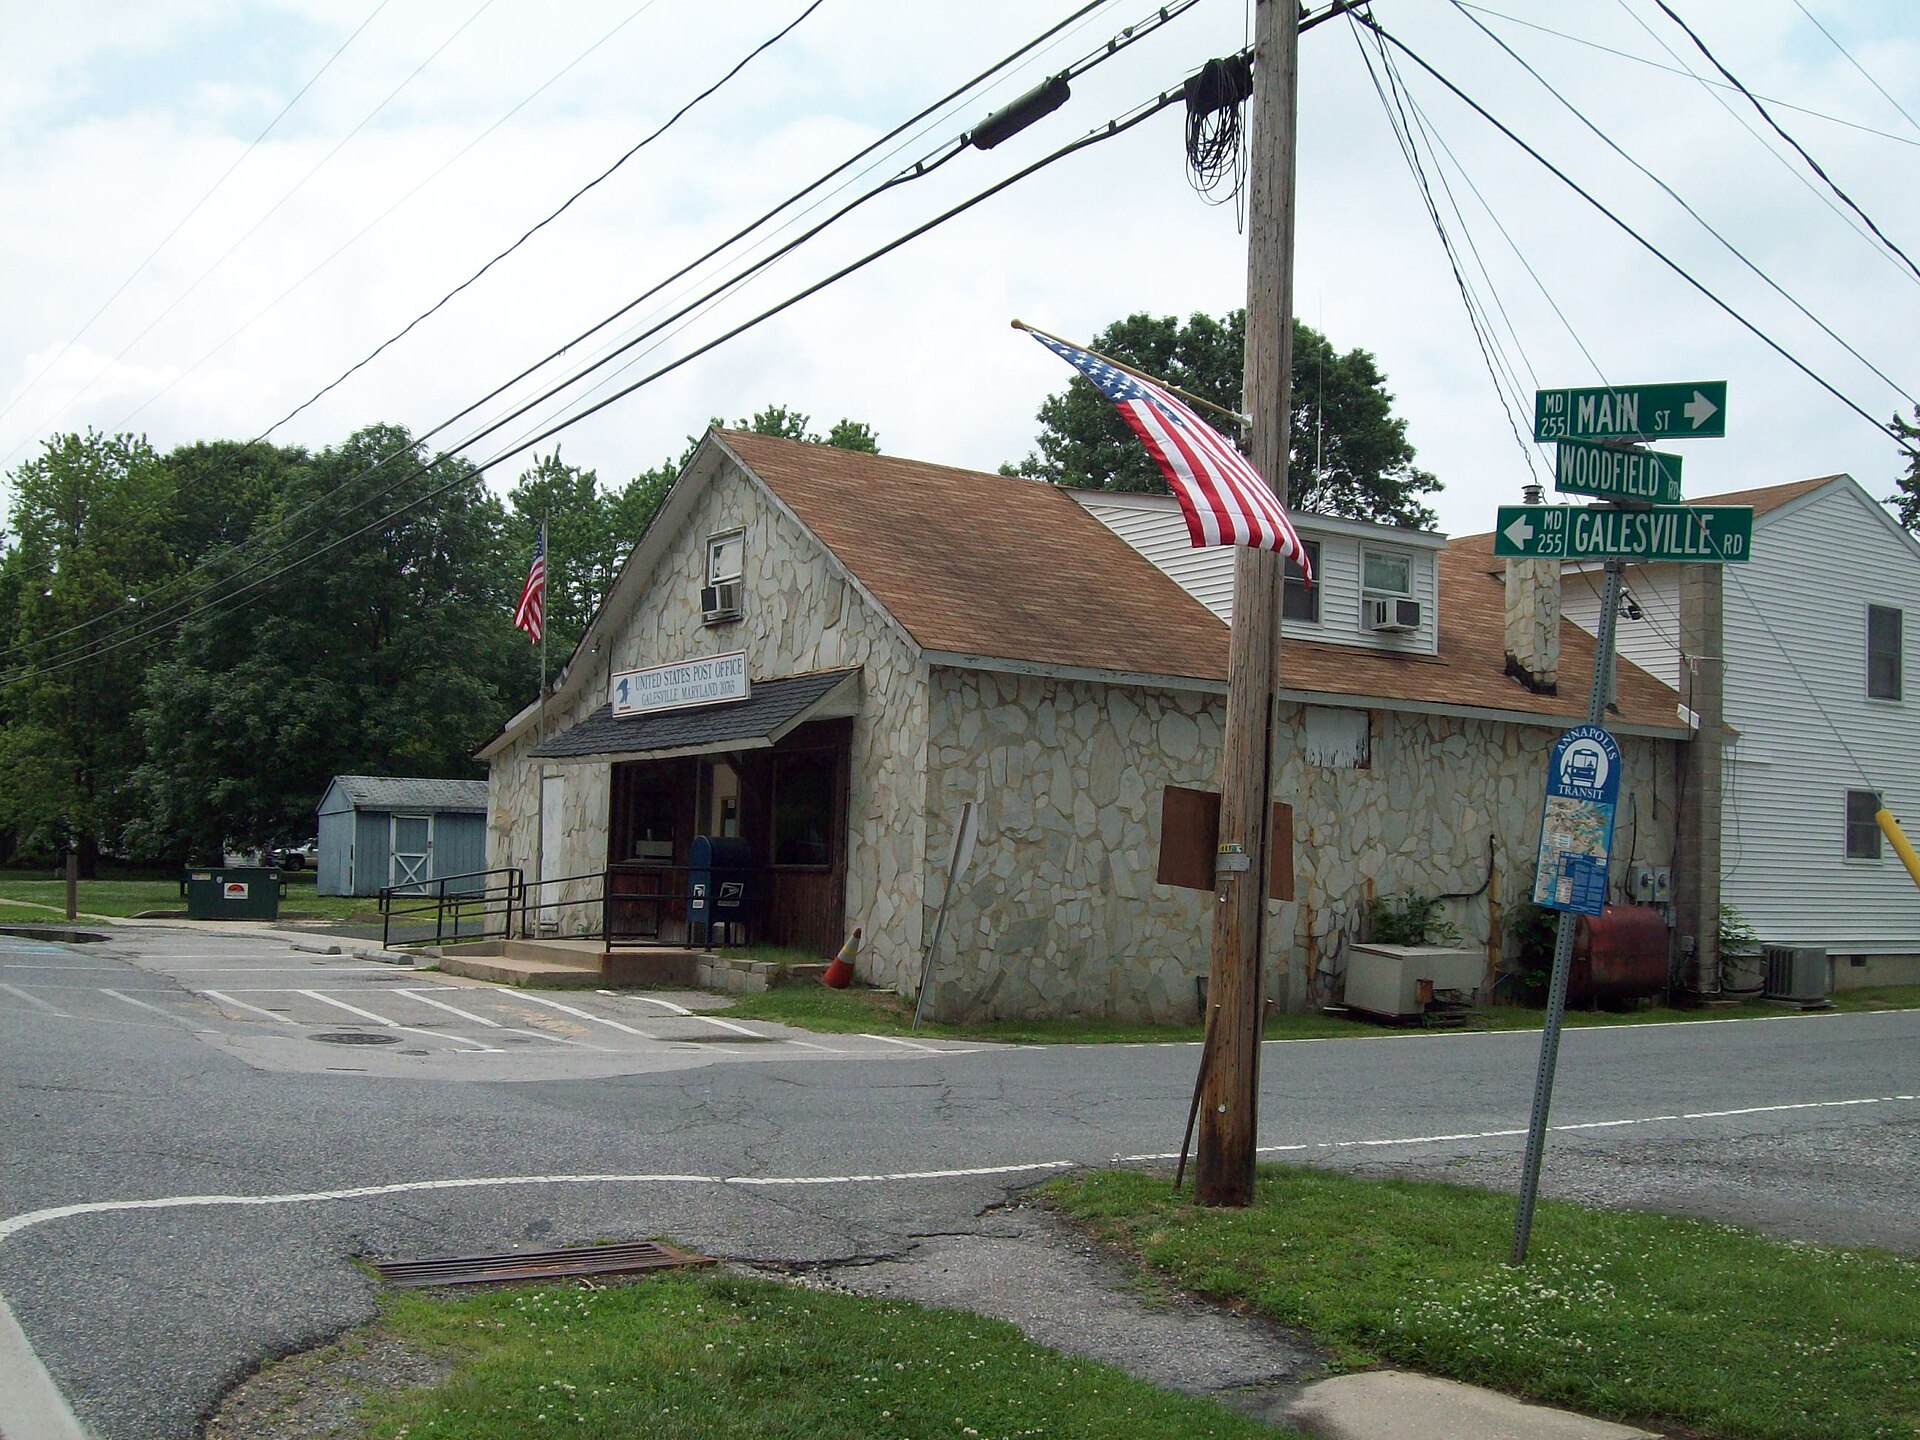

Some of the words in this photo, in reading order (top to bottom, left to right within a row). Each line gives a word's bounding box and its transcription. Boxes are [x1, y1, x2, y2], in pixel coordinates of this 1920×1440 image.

[1544, 394, 1563, 414] MD
[1577, 392, 1639, 434] MAIN
[1654, 410, 1671, 431] ST
[1541, 416, 1565, 437] 255
[1560, 443, 1660, 497] WOODFIELD
[1668, 481, 1679, 501] RD
[1543, 511, 1561, 530] MD
[1537, 534, 1562, 553] 255
[1575, 513, 1714, 554] GALESVILLE
[1723, 534, 1743, 555] RD
[635, 671, 662, 691] UNITED
[664, 667, 691, 686] STATES
[693, 663, 712, 682] POST
[715, 658, 743, 678] OFFICE
[681, 682, 718, 700] MARYLAND
[1557, 727, 1618, 761] ANNAPOLIS
[1558, 784, 1604, 800] TRANSIT
